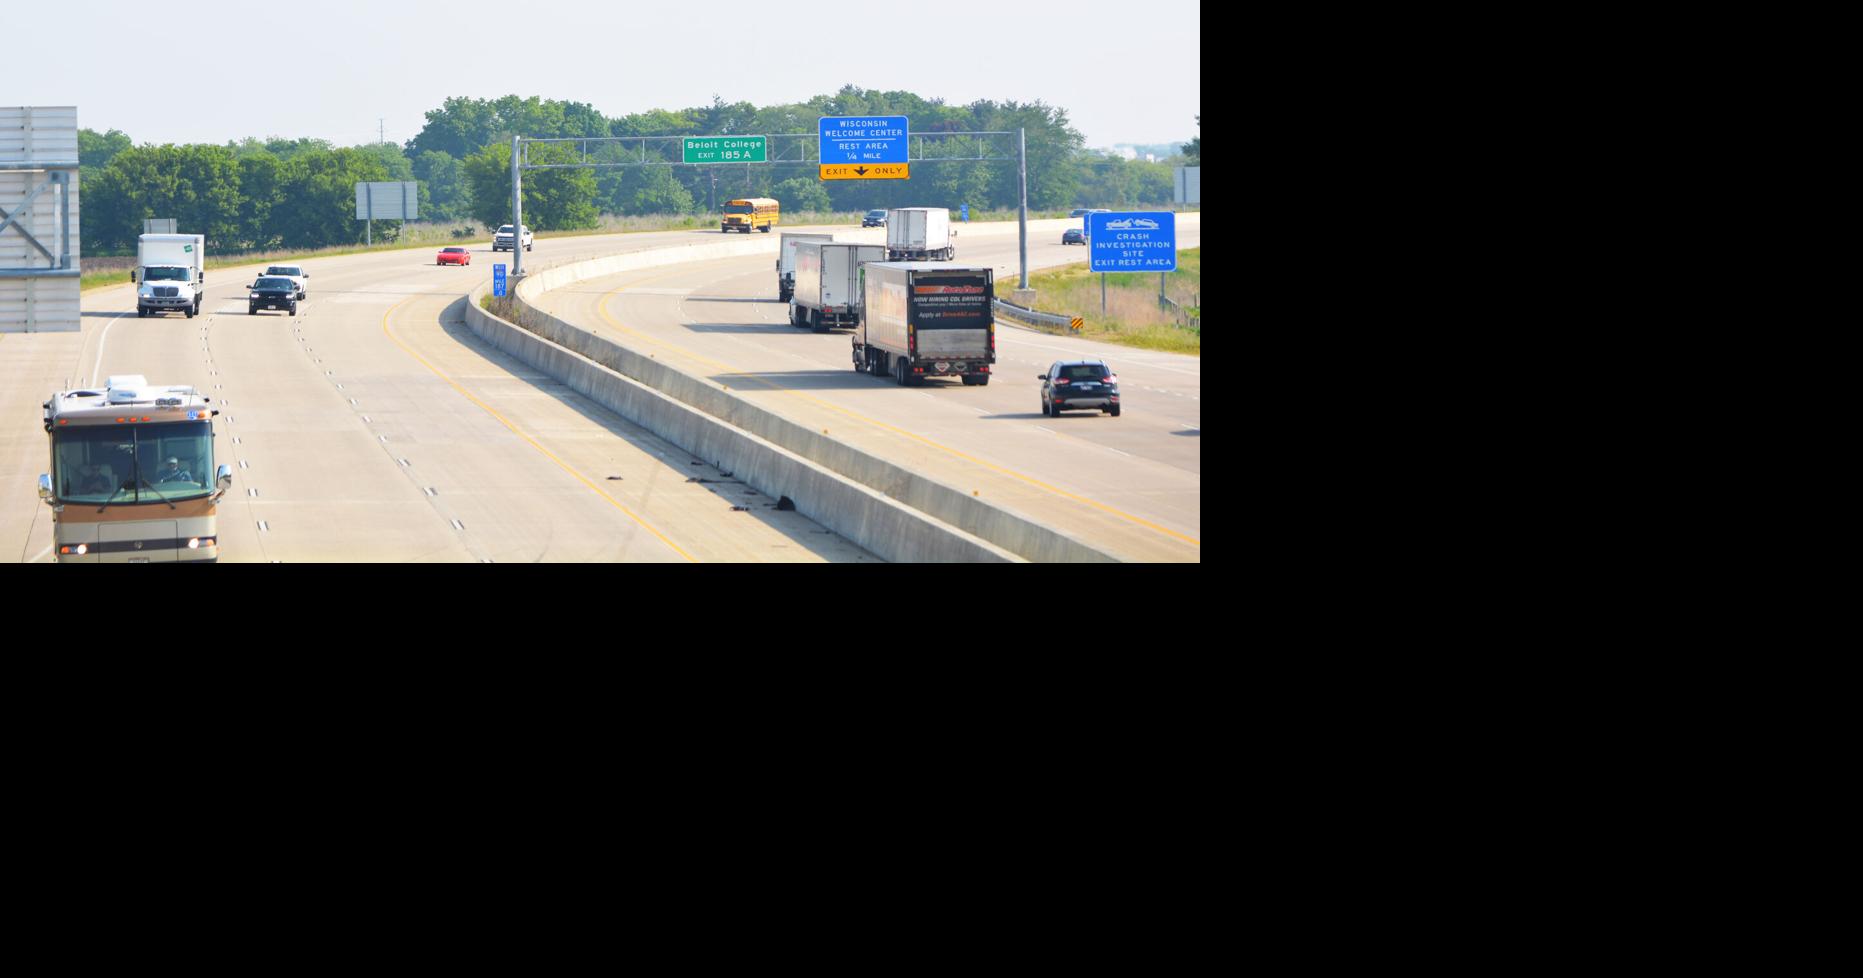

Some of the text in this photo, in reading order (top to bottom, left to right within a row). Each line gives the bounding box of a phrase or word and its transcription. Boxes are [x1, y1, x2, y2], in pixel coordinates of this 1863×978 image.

[840, 120, 888, 128] WISCONSIN
[825, 128, 903, 137] WELCOME CENTER
[687, 140, 762, 150] Beloit College
[865, 142, 888, 150] AREA
[720, 151, 741, 160] 185
[743, 150, 752, 159] A
[1096, 241, 1170, 249] INVESTIGATION
[1145, 258, 1172, 266] AREA
